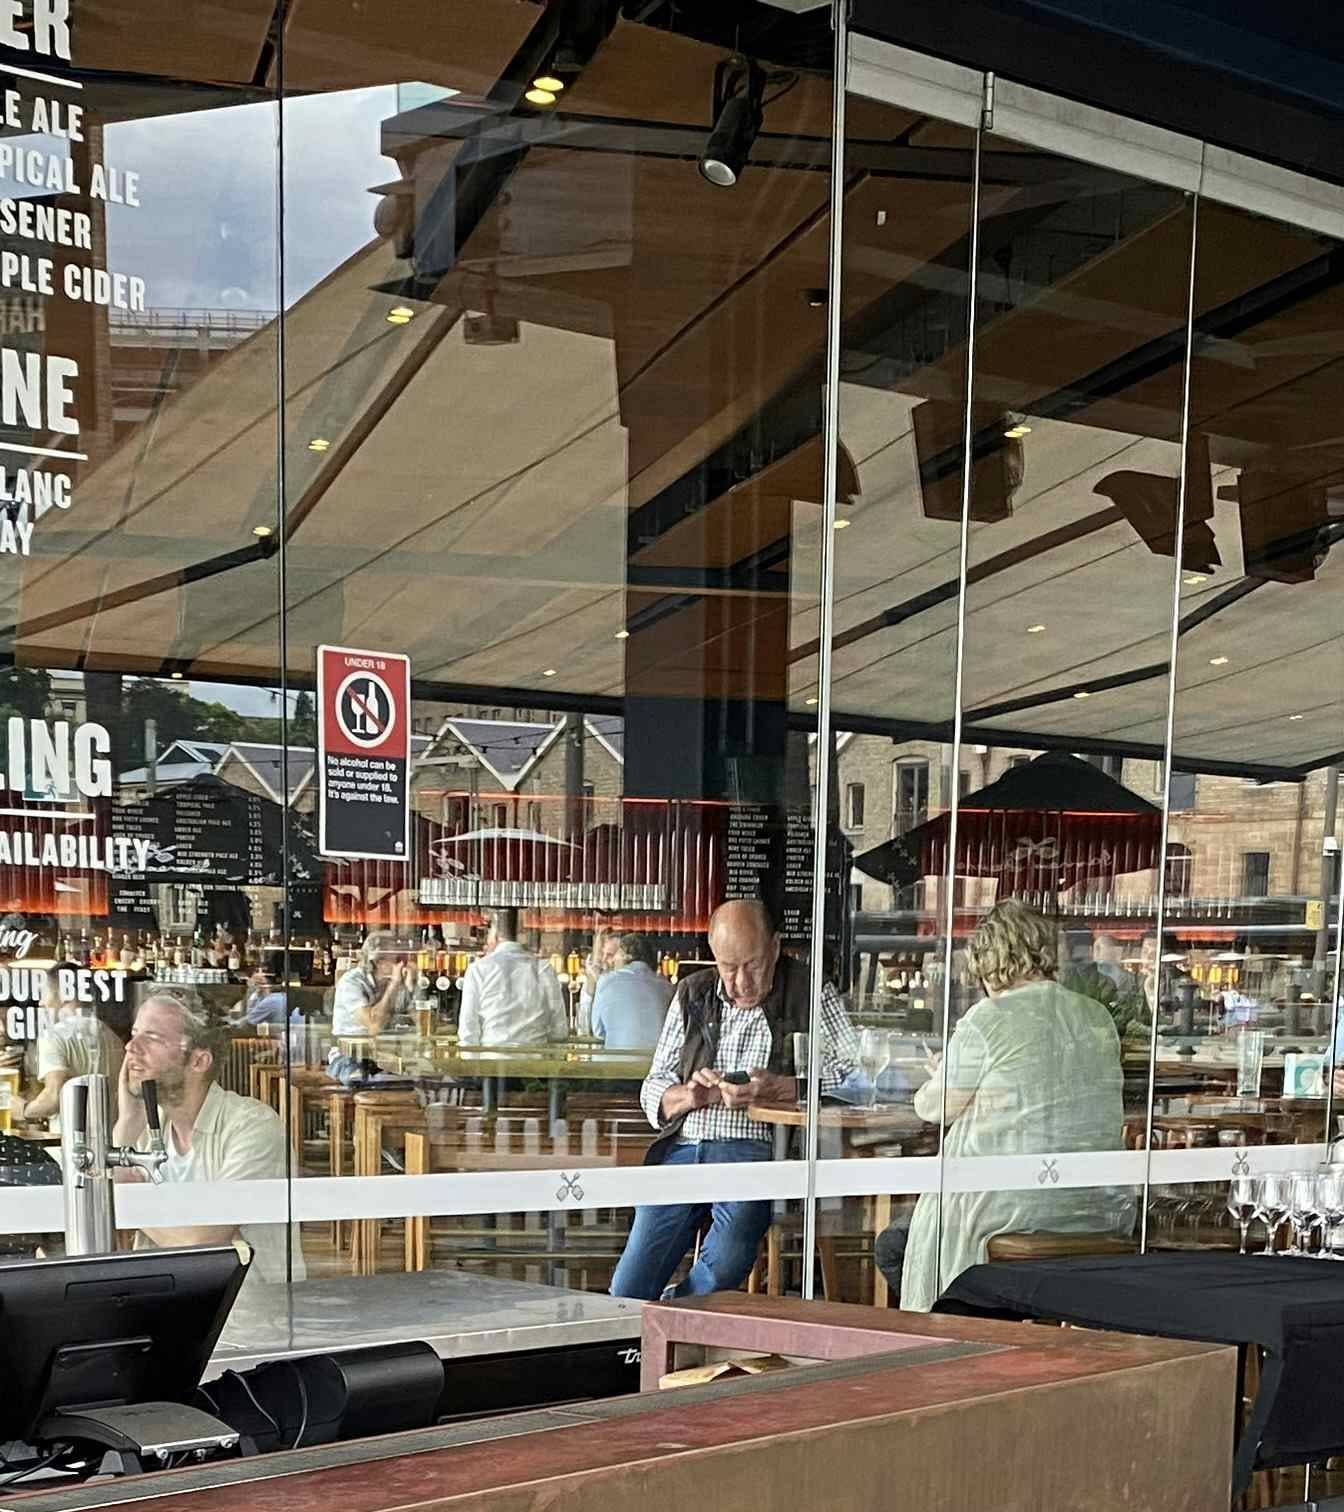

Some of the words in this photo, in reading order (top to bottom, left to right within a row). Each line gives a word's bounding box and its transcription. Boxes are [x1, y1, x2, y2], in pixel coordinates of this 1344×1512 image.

[31, 97, 84, 142] ALE
[89, 164, 140, 207] ALE
[64, 264, 145, 312] CIDER
[344, 657, 374, 669] UNDER
[376, 661, 386, 670] 18
[328, 755, 338, 765] No
[339, 757, 368, 768] alcohol
[369, 761, 384, 769] can
[385, 760, 396, 771] be
[328, 768, 344, 776] sold
[345, 770, 354, 778] or
[355, 771, 388, 781] supplied
[389, 773, 398, 782] to
[328, 780, 355, 790] anyone
[357, 782, 380, 791] under
[341, 792, 368, 801] against
[369, 793, 382, 802] the
[58, 969, 127, 1003] BEST
